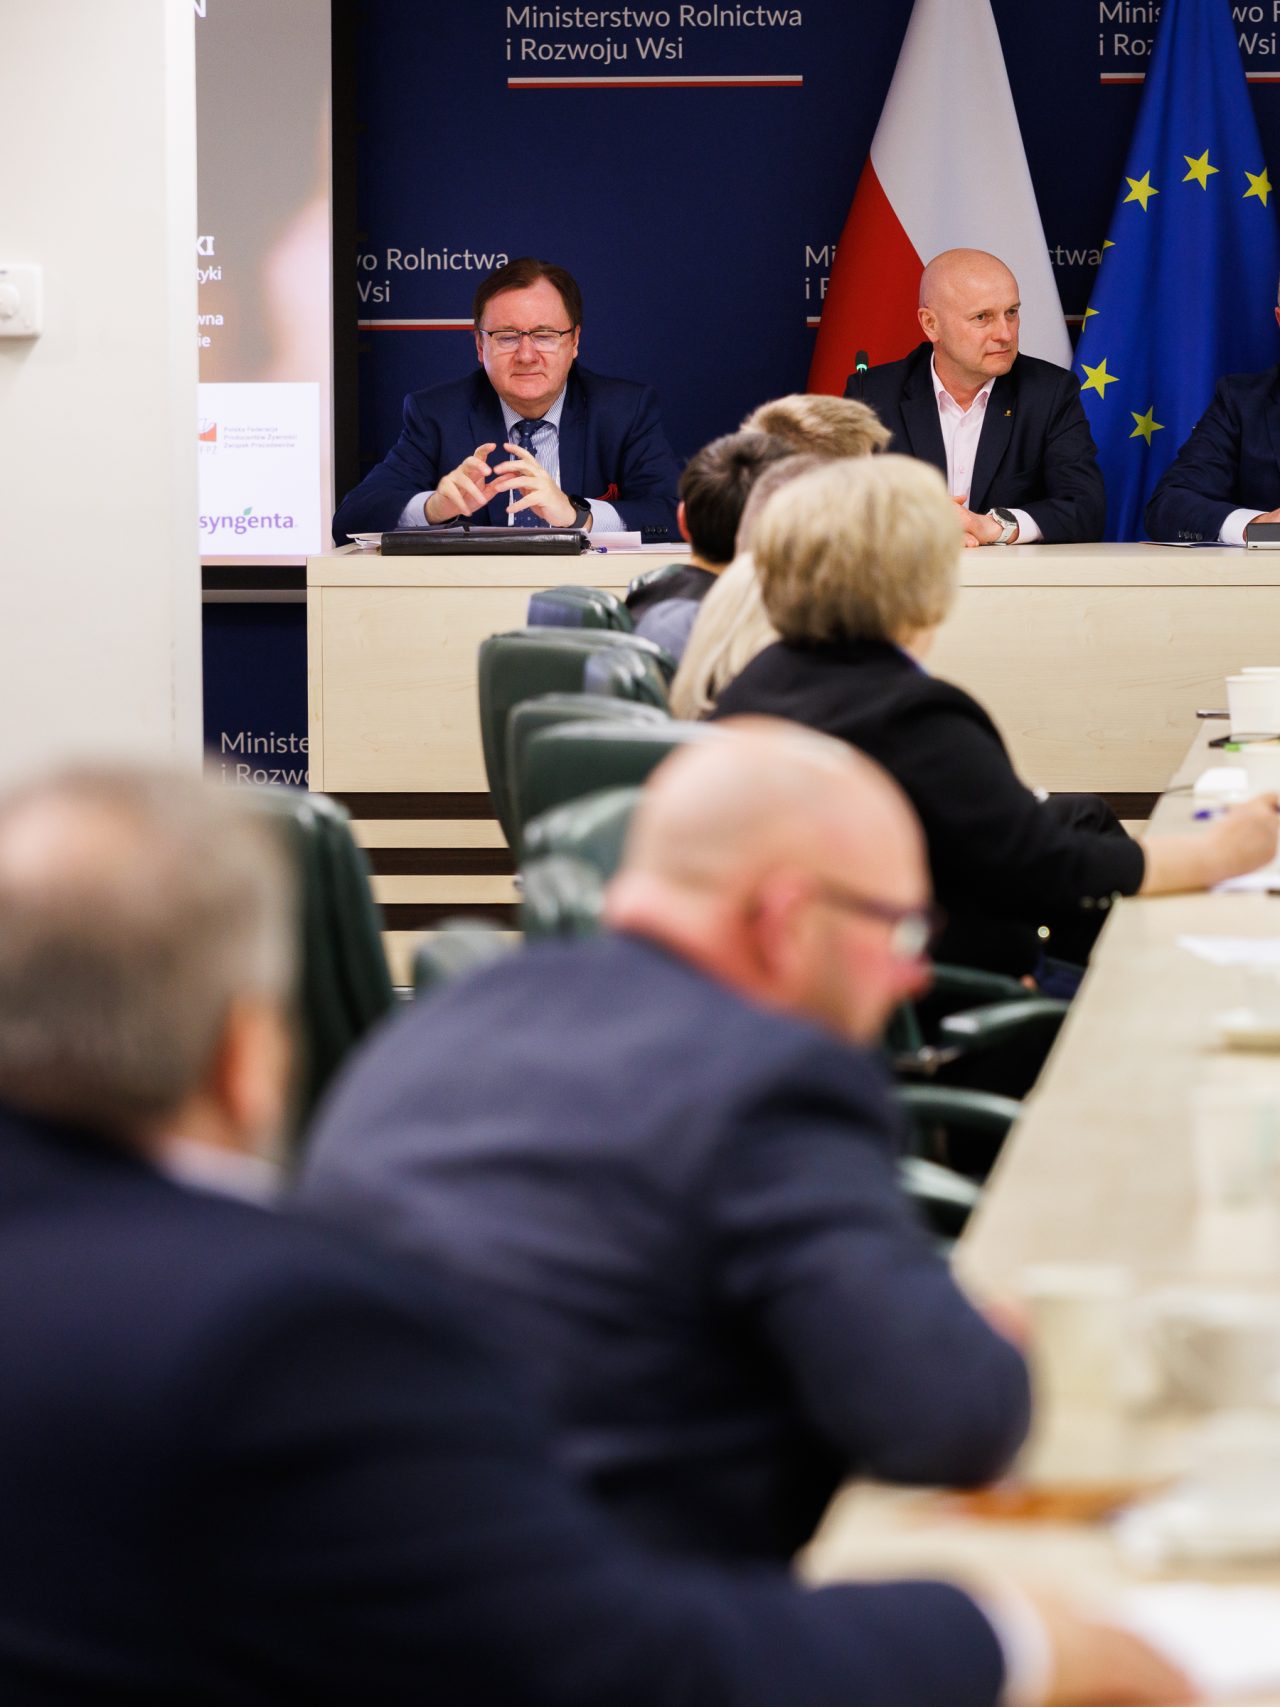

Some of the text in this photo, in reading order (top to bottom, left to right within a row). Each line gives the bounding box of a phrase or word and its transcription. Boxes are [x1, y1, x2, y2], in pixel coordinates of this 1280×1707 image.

[506, 4, 802, 28] Ministerstwo Rolnictwa
[506, 37, 684, 65] i Rozwoju Wsi
[1099, 34, 1104, 56] i
[387, 248, 509, 271] Rolnictwa
[196, 265, 222, 284] tyki
[804, 277, 810, 300] i
[199, 513, 294, 535] syngenta
[221, 731, 309, 754] Ministe
[236, 763, 309, 785] Rozw
